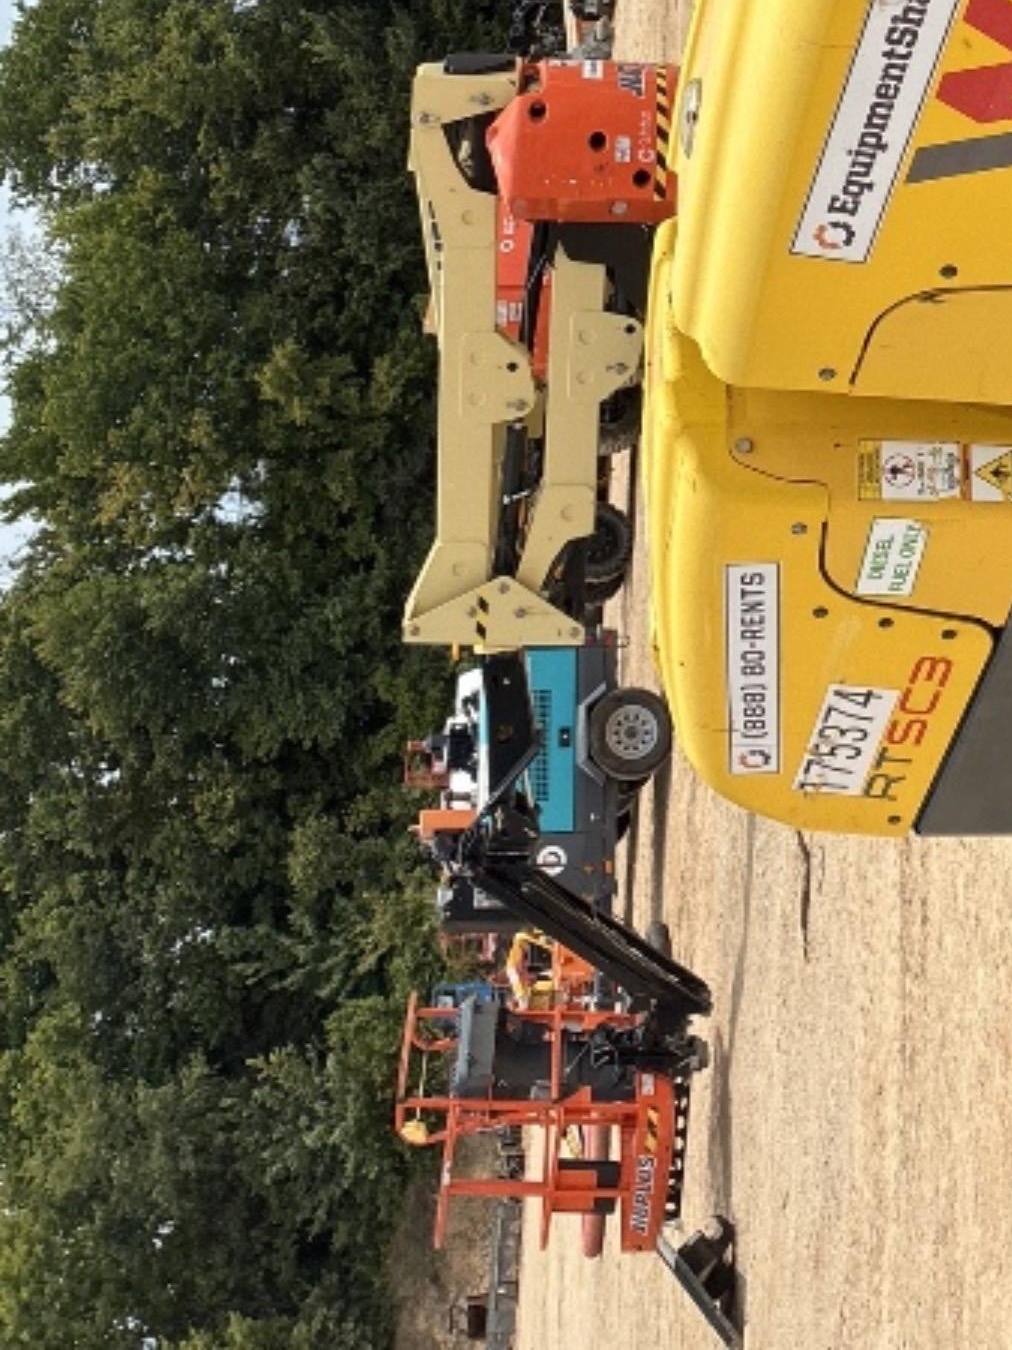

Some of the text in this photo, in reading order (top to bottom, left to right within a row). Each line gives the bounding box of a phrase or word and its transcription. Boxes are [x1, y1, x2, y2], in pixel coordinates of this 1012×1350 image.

[867, 534, 895, 580] DIESEL
[888, 524, 921, 592] FUEL ONLY
[739, 682, 769, 739] (888)
[799, 688, 884, 791] 175374
